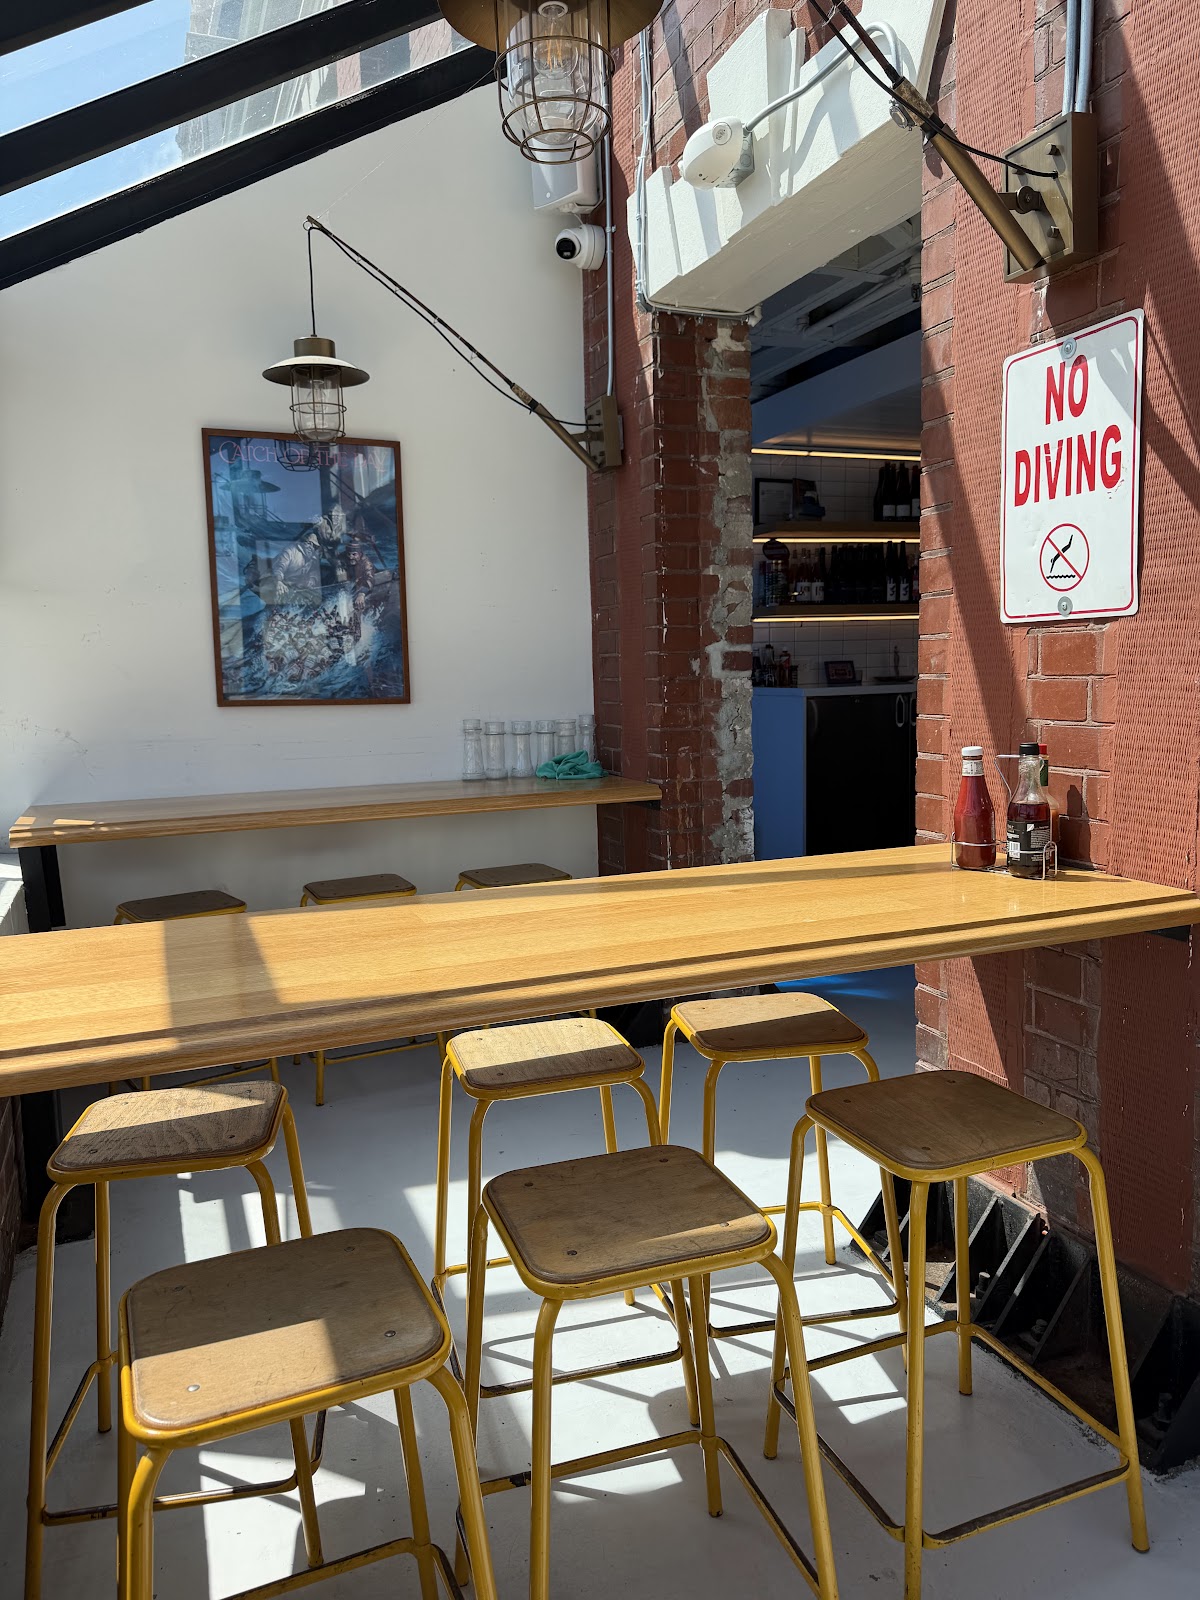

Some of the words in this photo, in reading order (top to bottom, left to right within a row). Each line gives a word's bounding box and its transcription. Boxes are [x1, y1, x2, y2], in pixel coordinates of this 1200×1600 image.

[1045, 355, 1089, 425] NO
[218, 440, 278, 464] CATCH
[283, 448, 310, 465] OF
[315, 449, 348, 467] THE
[1014, 424, 1122, 507] DIVING
